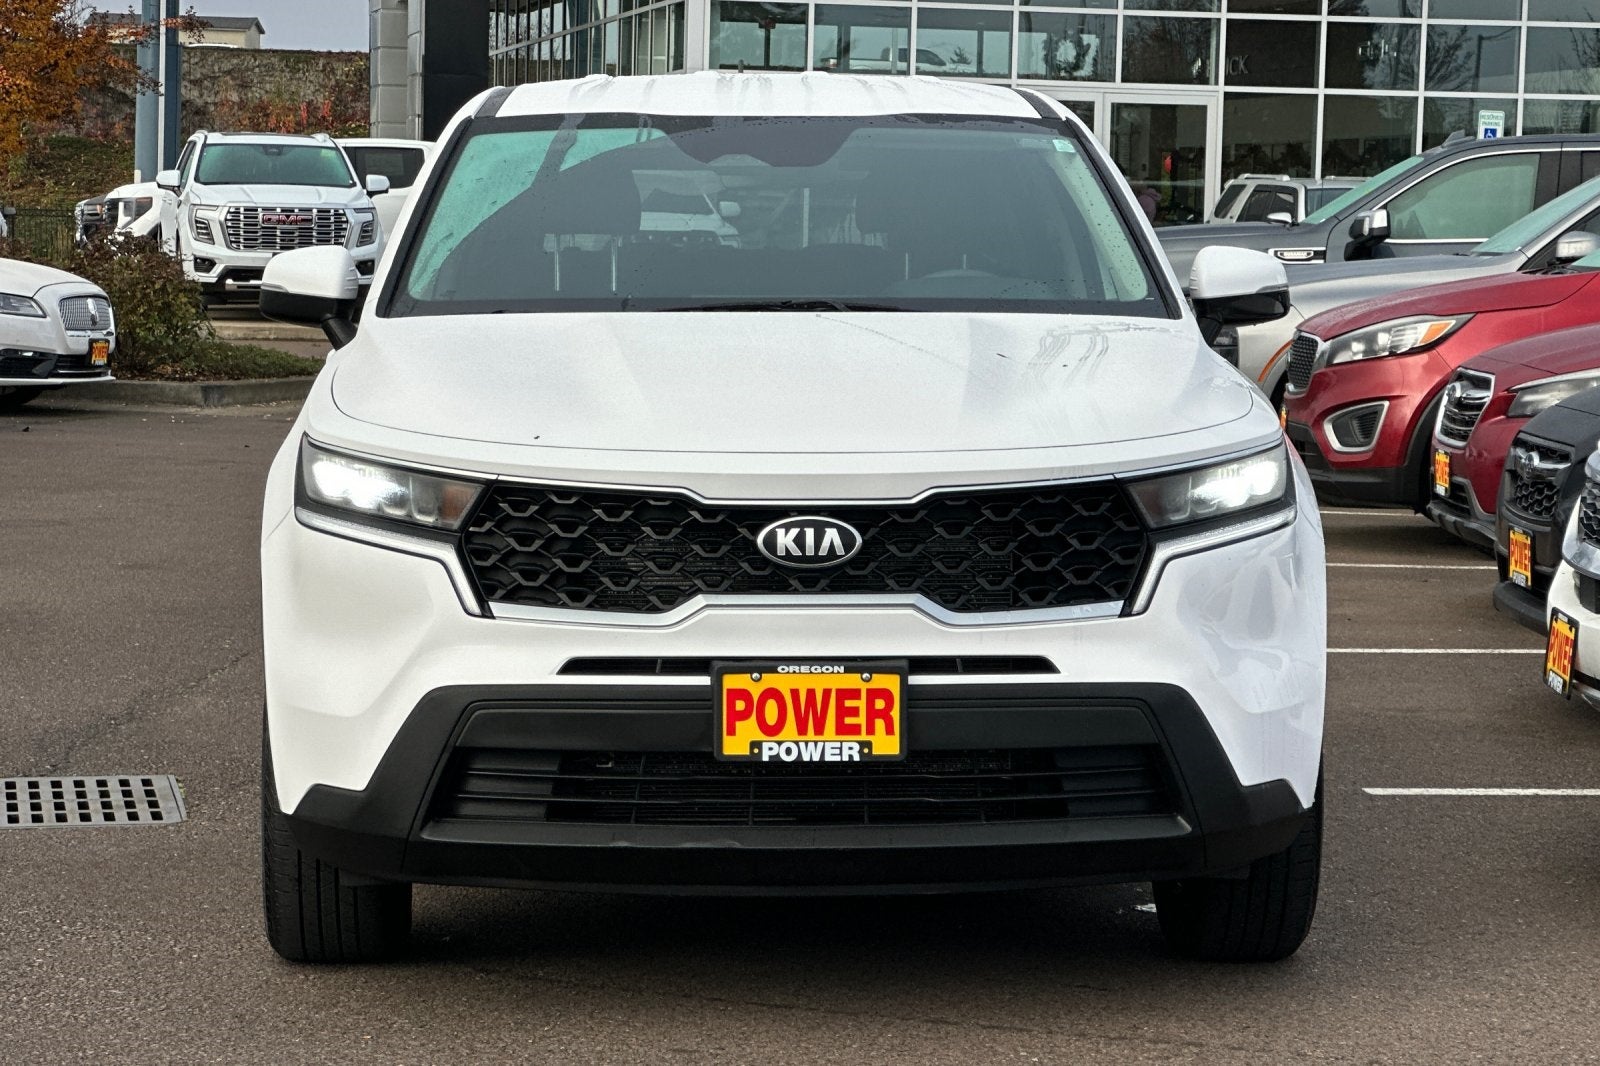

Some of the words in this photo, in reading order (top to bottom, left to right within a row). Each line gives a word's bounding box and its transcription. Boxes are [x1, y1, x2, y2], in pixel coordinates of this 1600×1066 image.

[263, 214, 312, 225] GMC
[775, 527, 845, 556] KIA
[1548, 625, 1574, 677] POWER
[777, 665, 845, 674] OREGON
[725, 686, 896, 738] POWER
[761, 741, 861, 763] POWER
